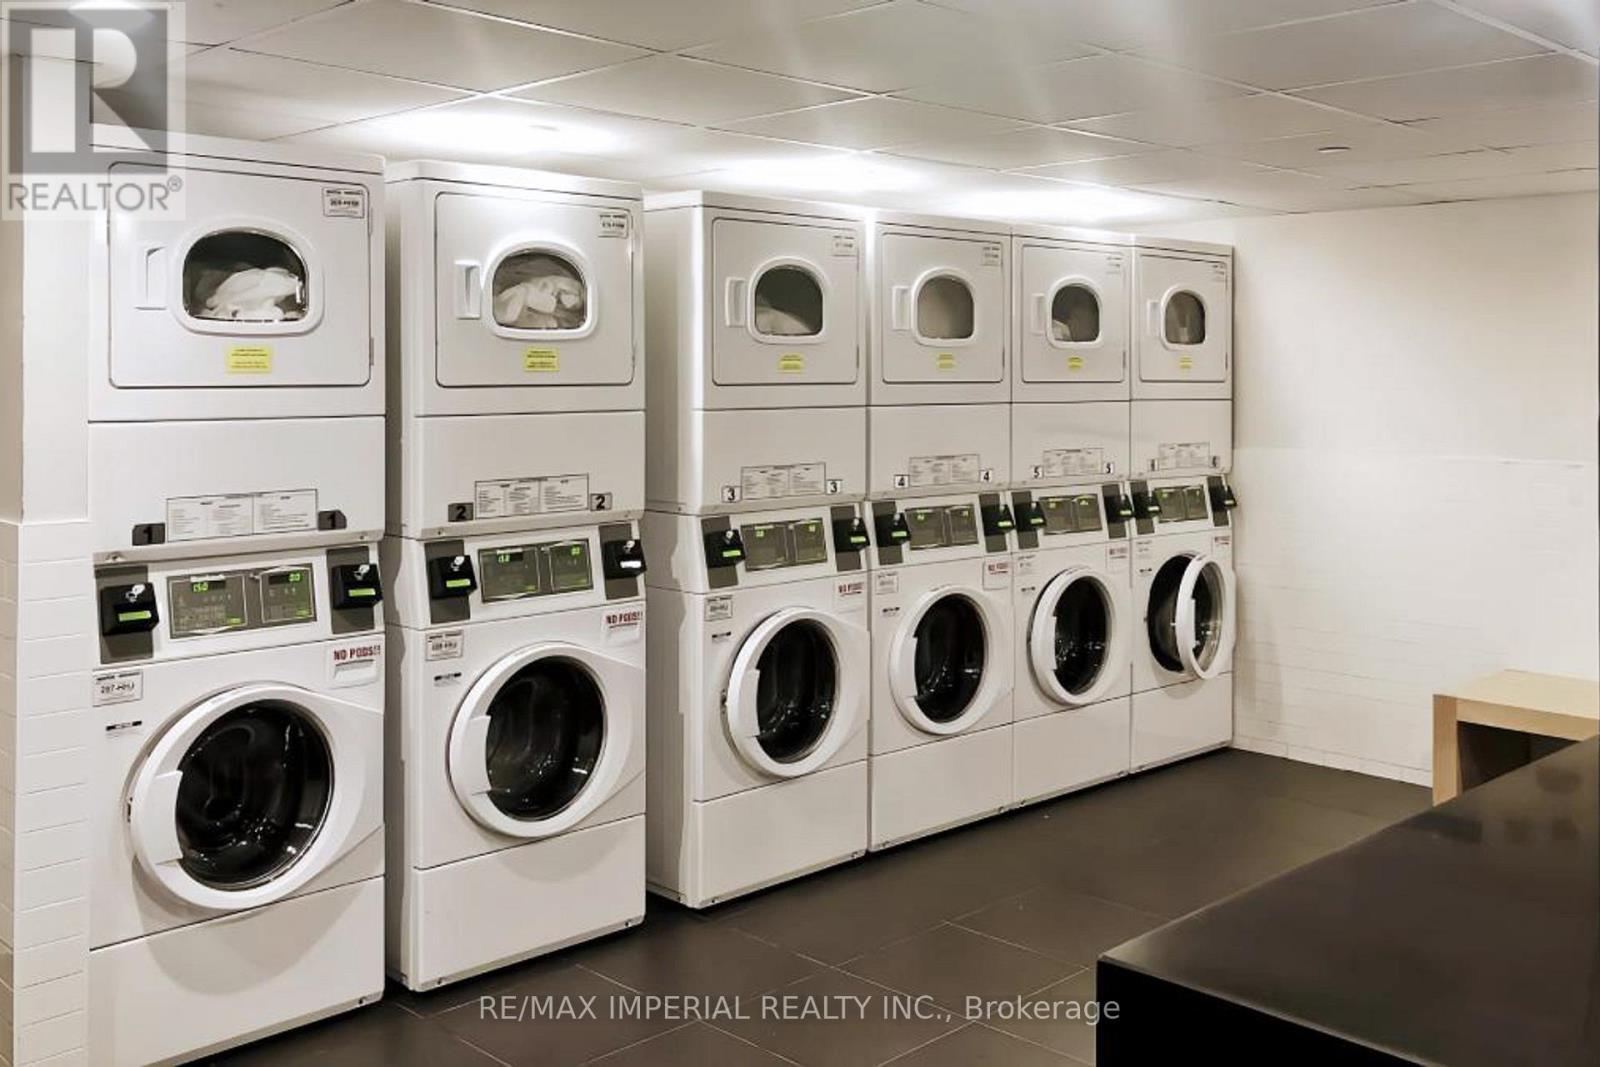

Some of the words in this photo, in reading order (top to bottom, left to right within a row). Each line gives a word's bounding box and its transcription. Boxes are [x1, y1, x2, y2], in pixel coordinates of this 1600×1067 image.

[983, 471, 990, 481] 4
[830, 482, 838, 493] 3
[727, 488, 736, 501] 3
[596, 496, 606, 510] 2
[456, 506, 467, 518] 2
[325, 513, 337, 529] 1
[141, 526, 154, 543] 1
[333, 648, 347, 661] NO
[349, 644, 381, 659] PODS!!
